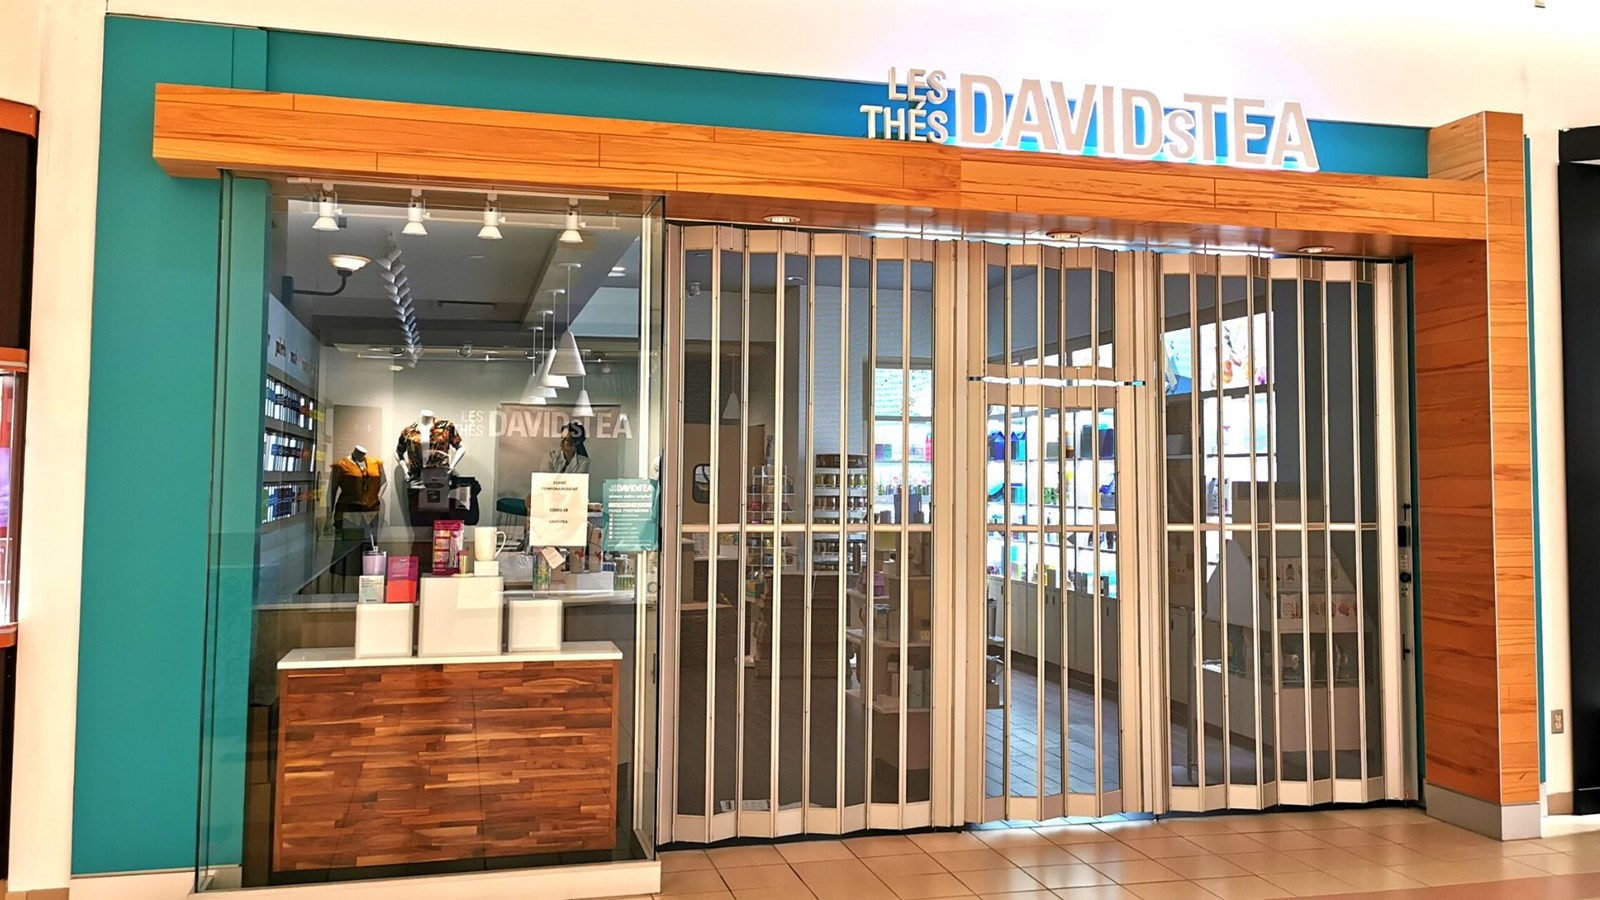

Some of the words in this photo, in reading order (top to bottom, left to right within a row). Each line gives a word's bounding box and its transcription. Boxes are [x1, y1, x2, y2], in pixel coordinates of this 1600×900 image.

[888, 66, 948, 104] LES
[860, 101, 949, 143] THÉS
[461, 410, 484, 423] LES
